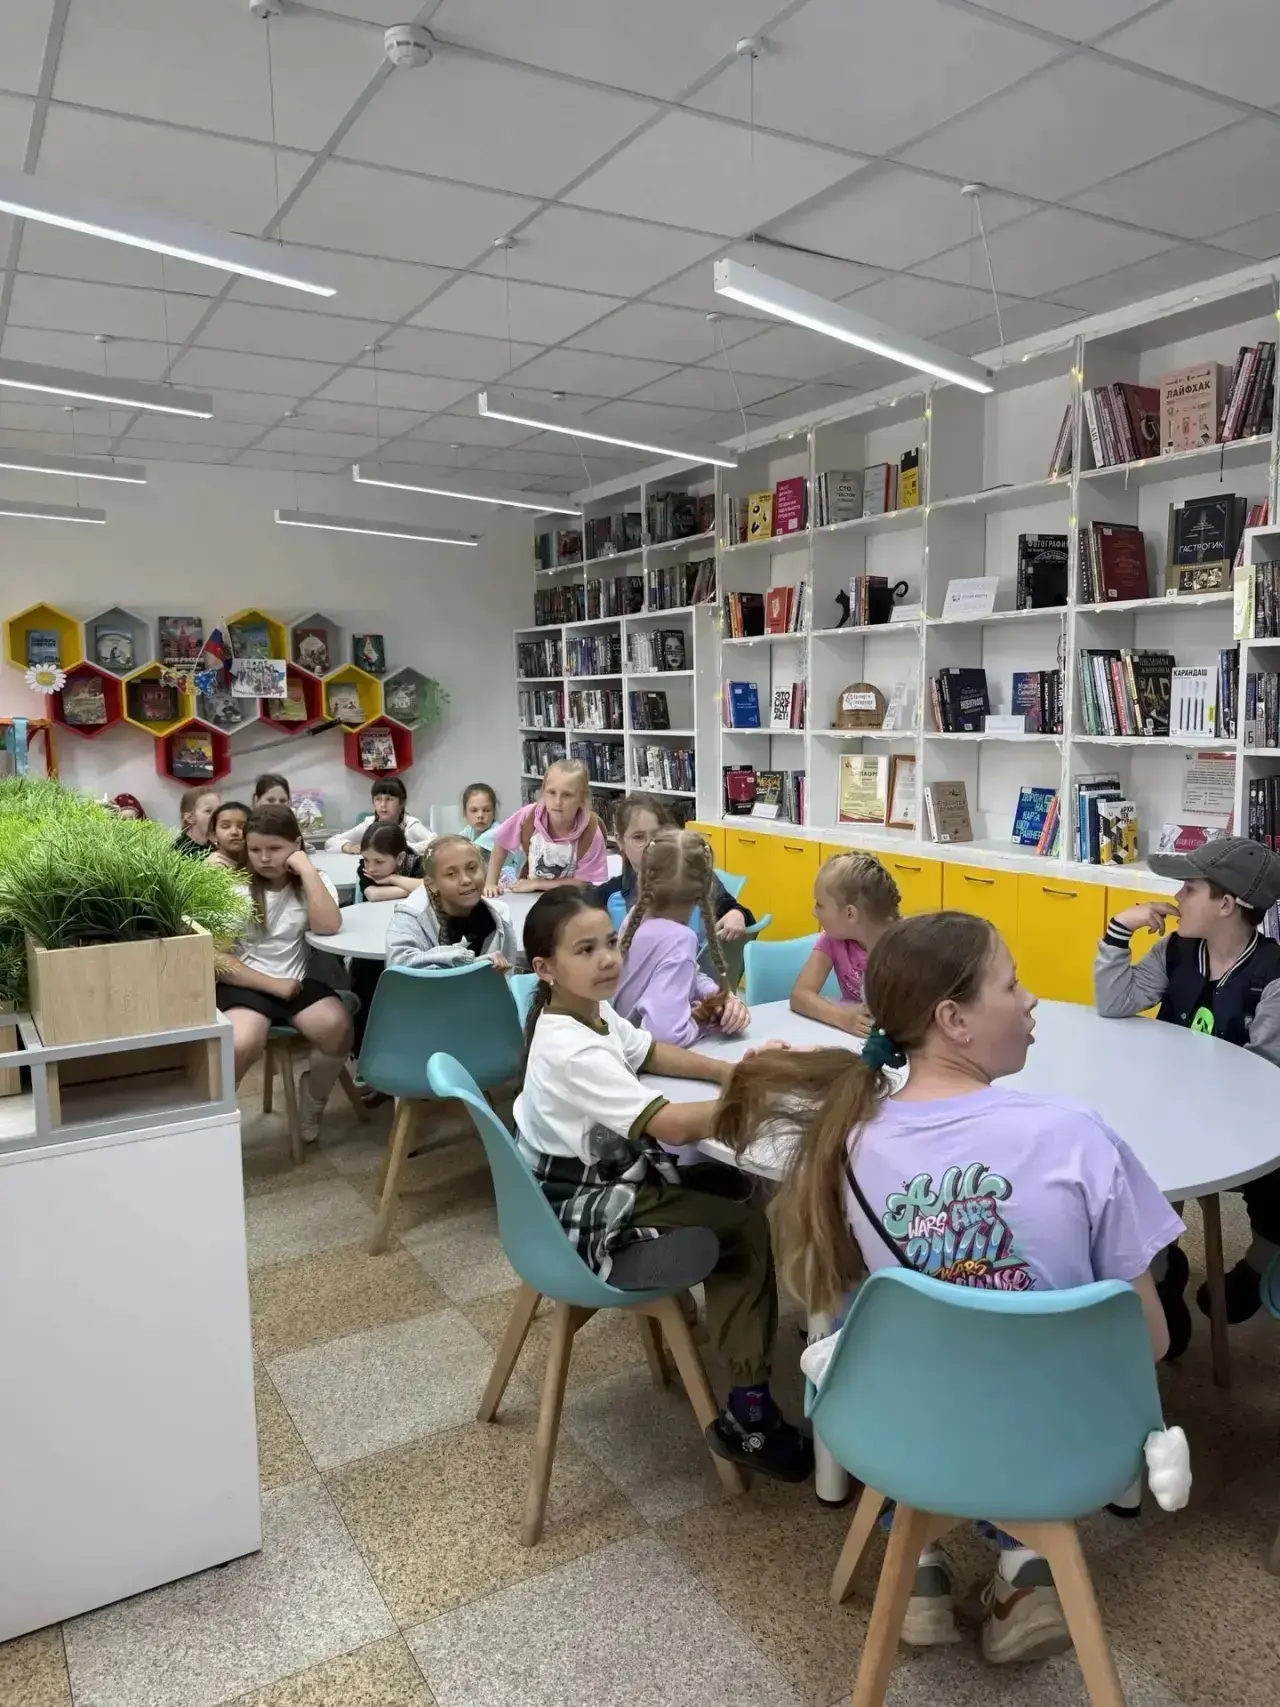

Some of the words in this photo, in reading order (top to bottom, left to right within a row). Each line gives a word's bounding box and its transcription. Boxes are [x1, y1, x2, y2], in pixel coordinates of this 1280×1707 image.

[1167, 380, 1211, 399] ЛАЙФХАК
[1180, 541, 1224, 553] ГАСТРОГИК
[1173, 668, 1208, 677] КАРАНДАШ
[775, 691, 790, 700] ЭТО
[1247, 730, 1254, 744] Б
[1120, 805, 1134, 813] АРХИ
[1022, 811, 1041, 821] КАРТА
[950, 1199, 997, 1232] ARE
[908, 1211, 947, 1238] WARS
[931, 1258, 988, 1282] WARS
